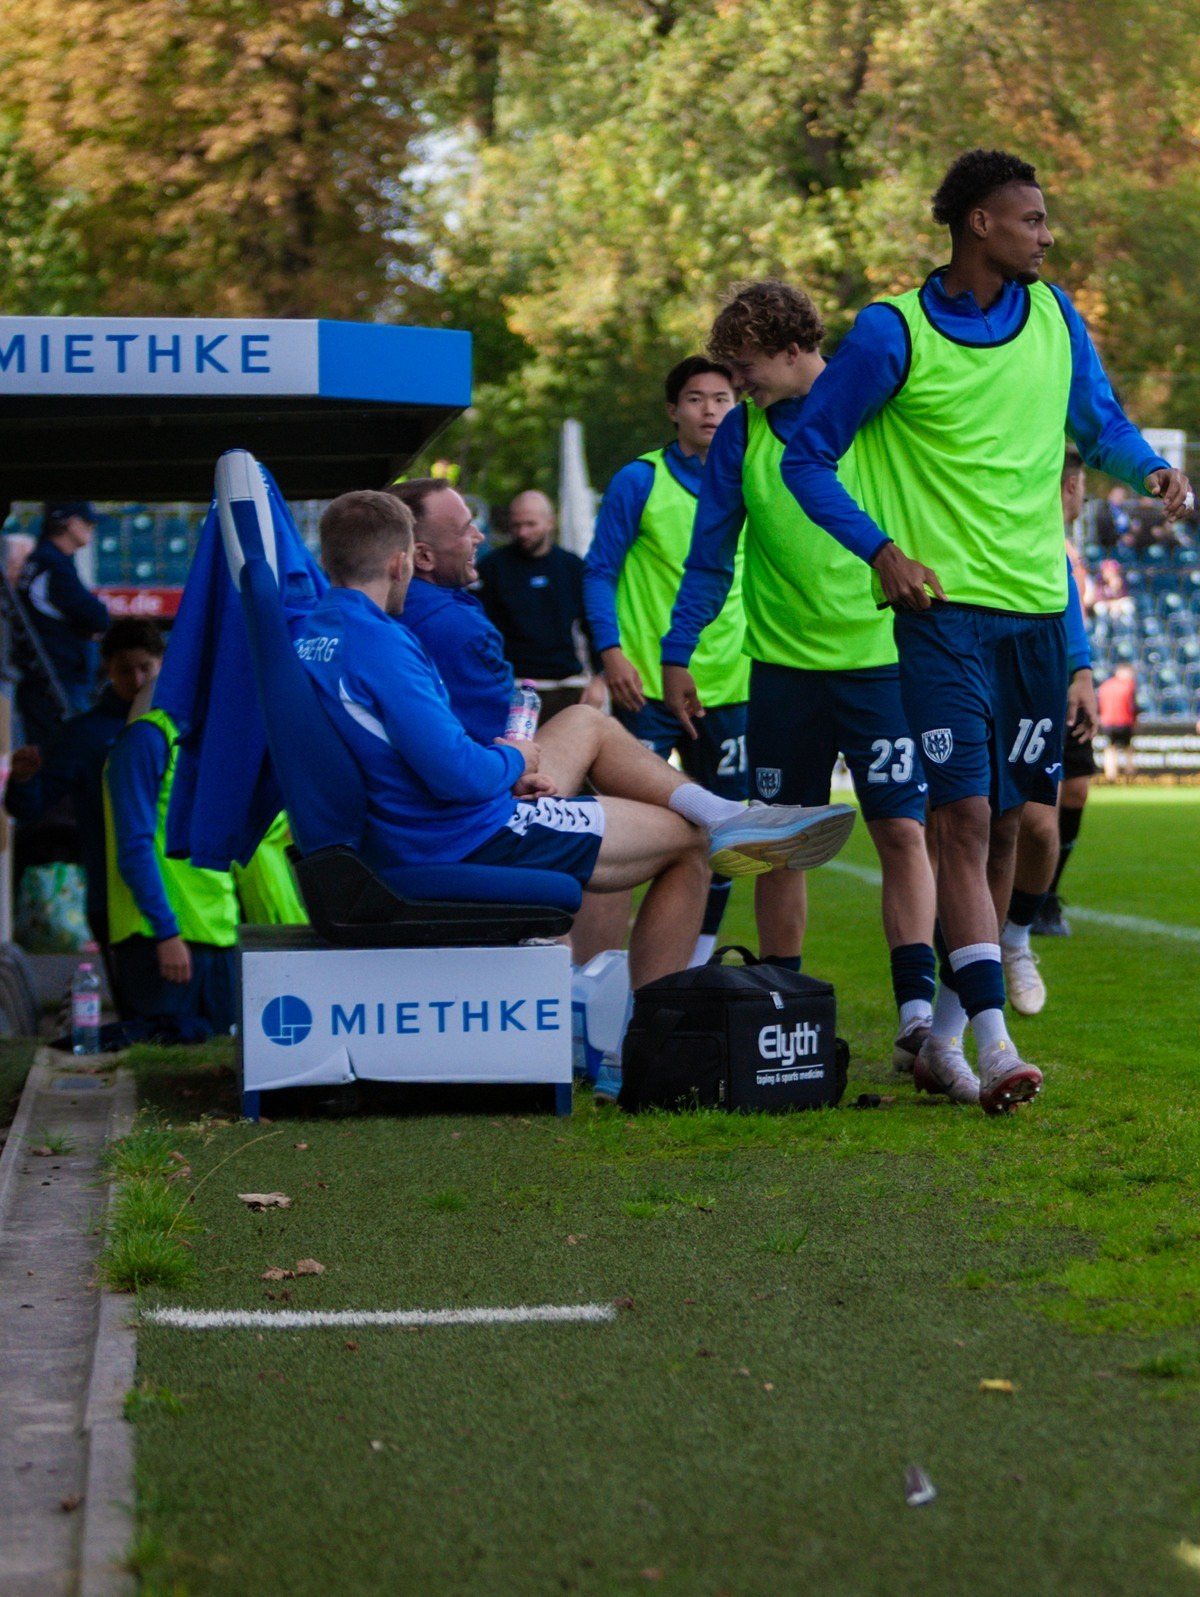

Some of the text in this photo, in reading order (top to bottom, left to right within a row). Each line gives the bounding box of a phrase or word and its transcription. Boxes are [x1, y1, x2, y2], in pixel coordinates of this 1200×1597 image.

[0, 334, 271, 374] MIETHKE
[717, 735, 748, 776] 21
[867, 737, 915, 783] 23
[1008, 717, 1053, 764] 16
[332, 999, 560, 1037] MIETHKE
[758, 1021, 818, 1066] Elyth
[756, 1074, 775, 1086] taping
[781, 1071, 799, 1084] sports
[799, 1069, 824, 1080] medicine
